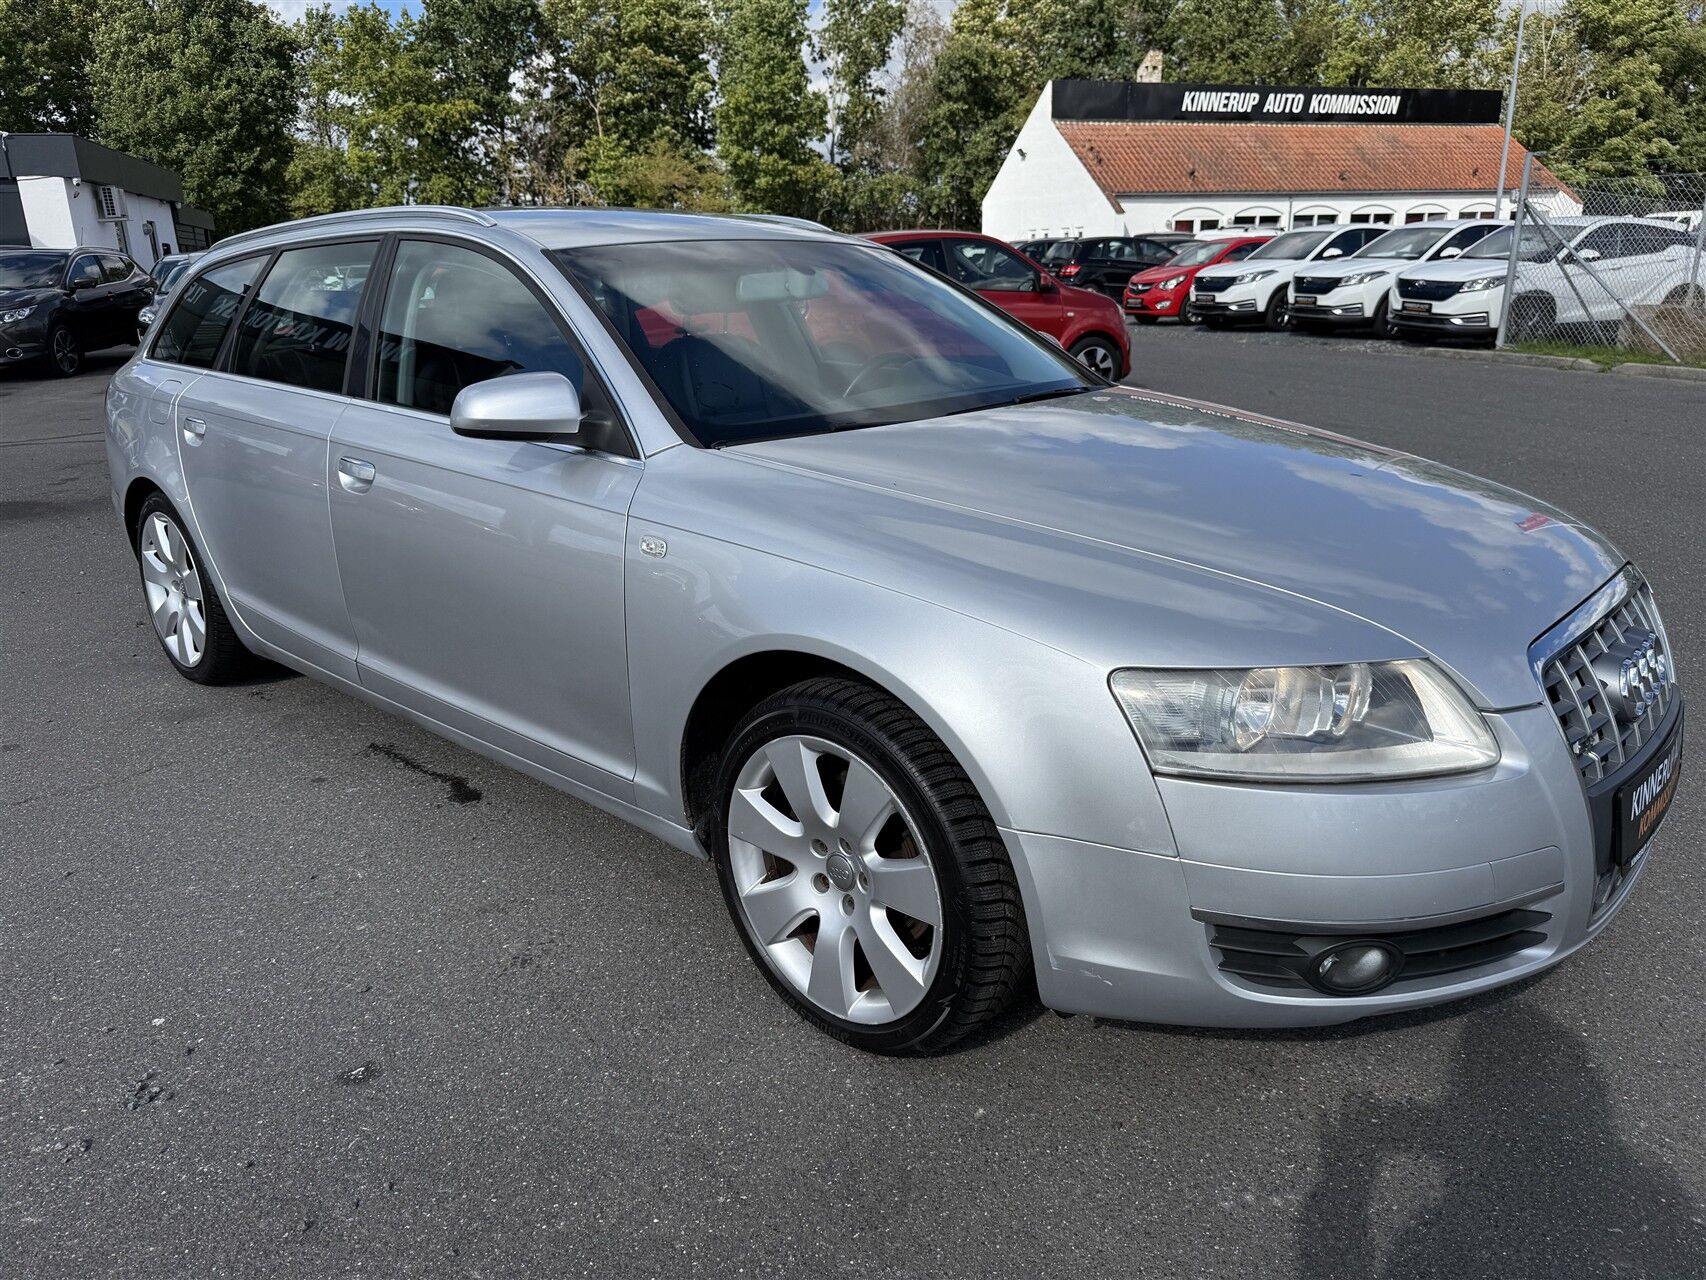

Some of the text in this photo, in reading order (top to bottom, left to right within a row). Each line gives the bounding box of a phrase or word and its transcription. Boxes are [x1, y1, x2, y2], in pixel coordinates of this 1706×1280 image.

[1181, 91, 1401, 115] KINNERUP AUTO KOMMISSION
